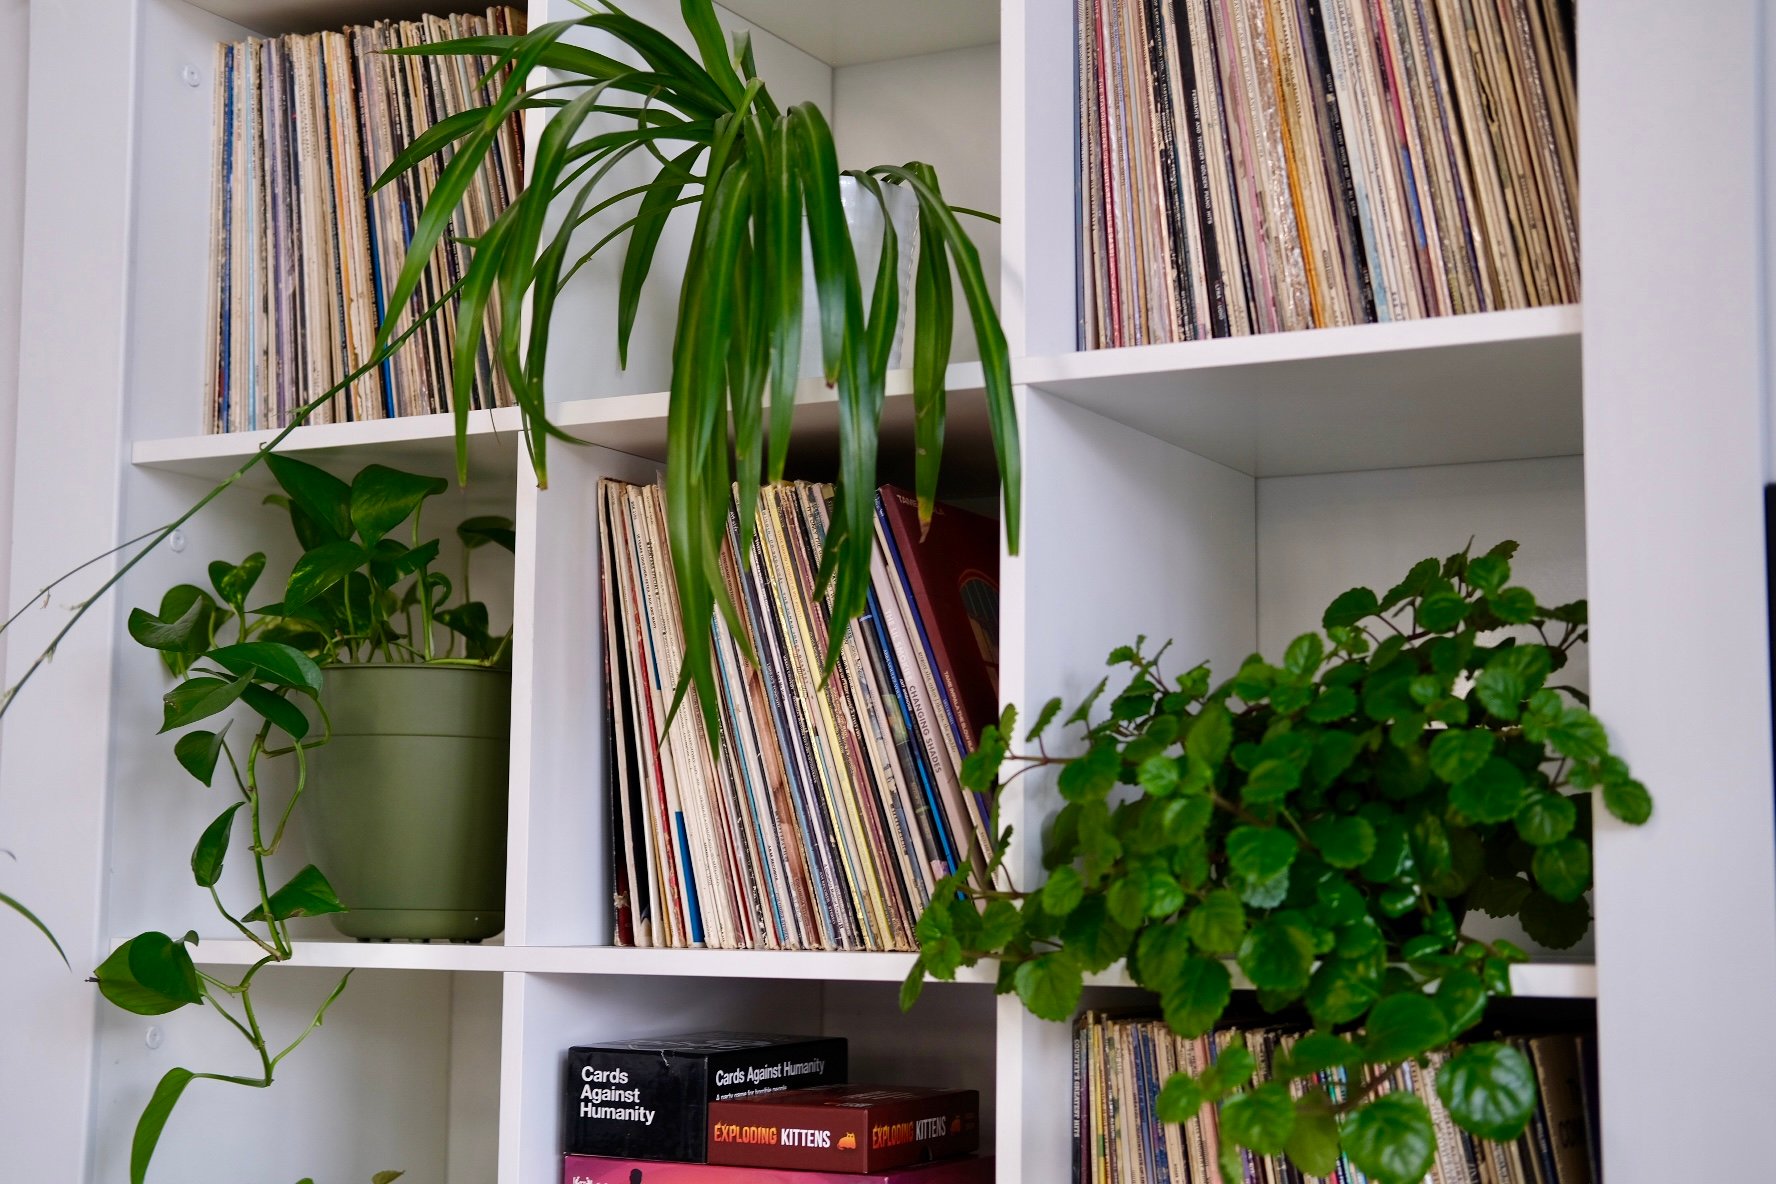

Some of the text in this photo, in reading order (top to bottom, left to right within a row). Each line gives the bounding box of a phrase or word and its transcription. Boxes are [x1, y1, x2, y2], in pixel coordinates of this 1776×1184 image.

[1191, 89, 1199, 118] FERRANTE
[1196, 136, 1204, 160] TEICHER
[884, 608, 942, 774] THE LIL SMOKIES CHANGING SHADES
[943, 671, 952, 688] TAME
[948, 687, 960, 710] IMPALA
[956, 710, 964, 722] THE
[960, 722, 970, 740] SLOW
[581, 1065, 628, 1084] Cards
[716, 1058, 825, 1086] Cards Against Humanity
[580, 1084, 640, 1104] Against
[580, 1102, 656, 1126] Humanity
[714, 1122, 830, 1148] EXPLODING KITTENS
[872, 1116, 946, 1149] EXPLODING KITTENS
